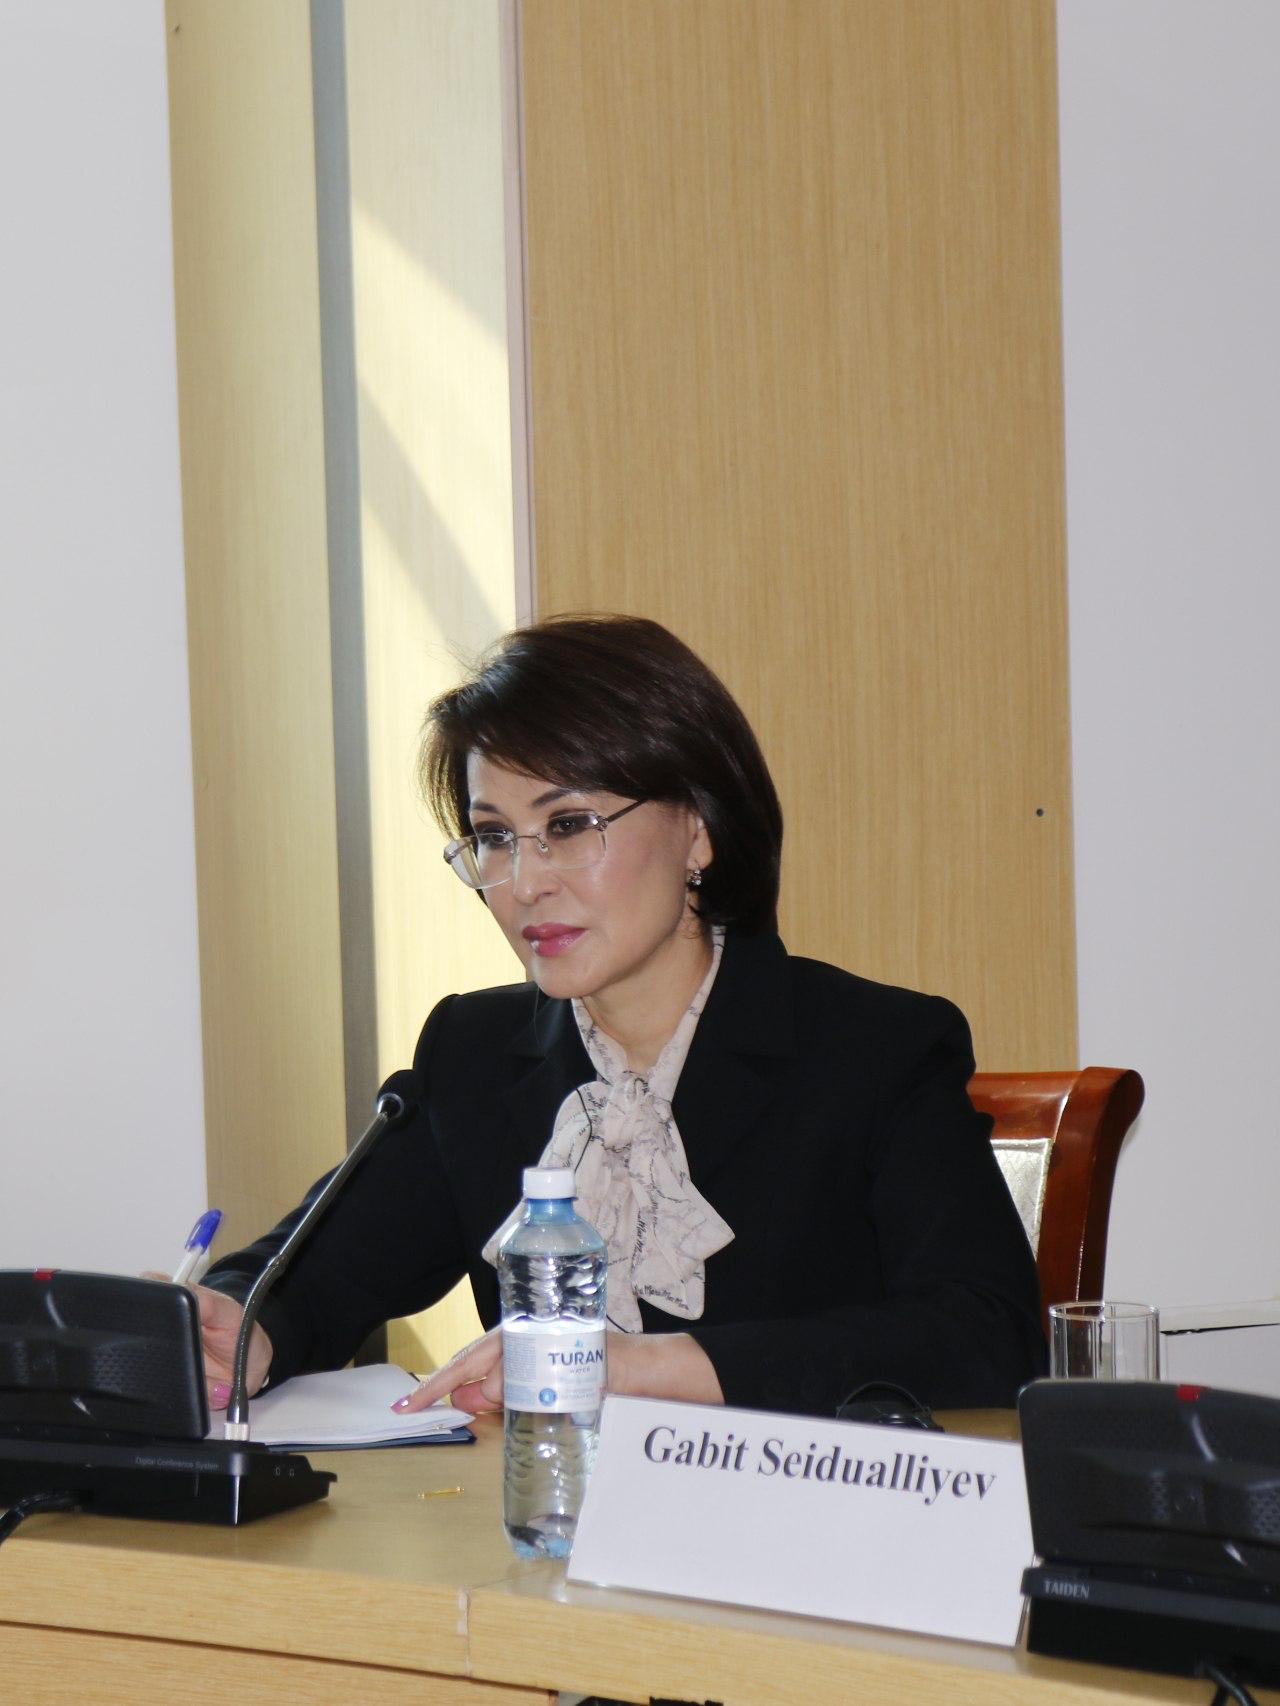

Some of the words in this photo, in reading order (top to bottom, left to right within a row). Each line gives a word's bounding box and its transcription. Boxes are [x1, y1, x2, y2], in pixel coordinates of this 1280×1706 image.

[548, 1349, 604, 1366] TURAN
[644, 1425, 749, 1472] Gabit
[757, 1438, 997, 1506] Seidualliyev
[1043, 1579, 1090, 1599] TAIDEN
